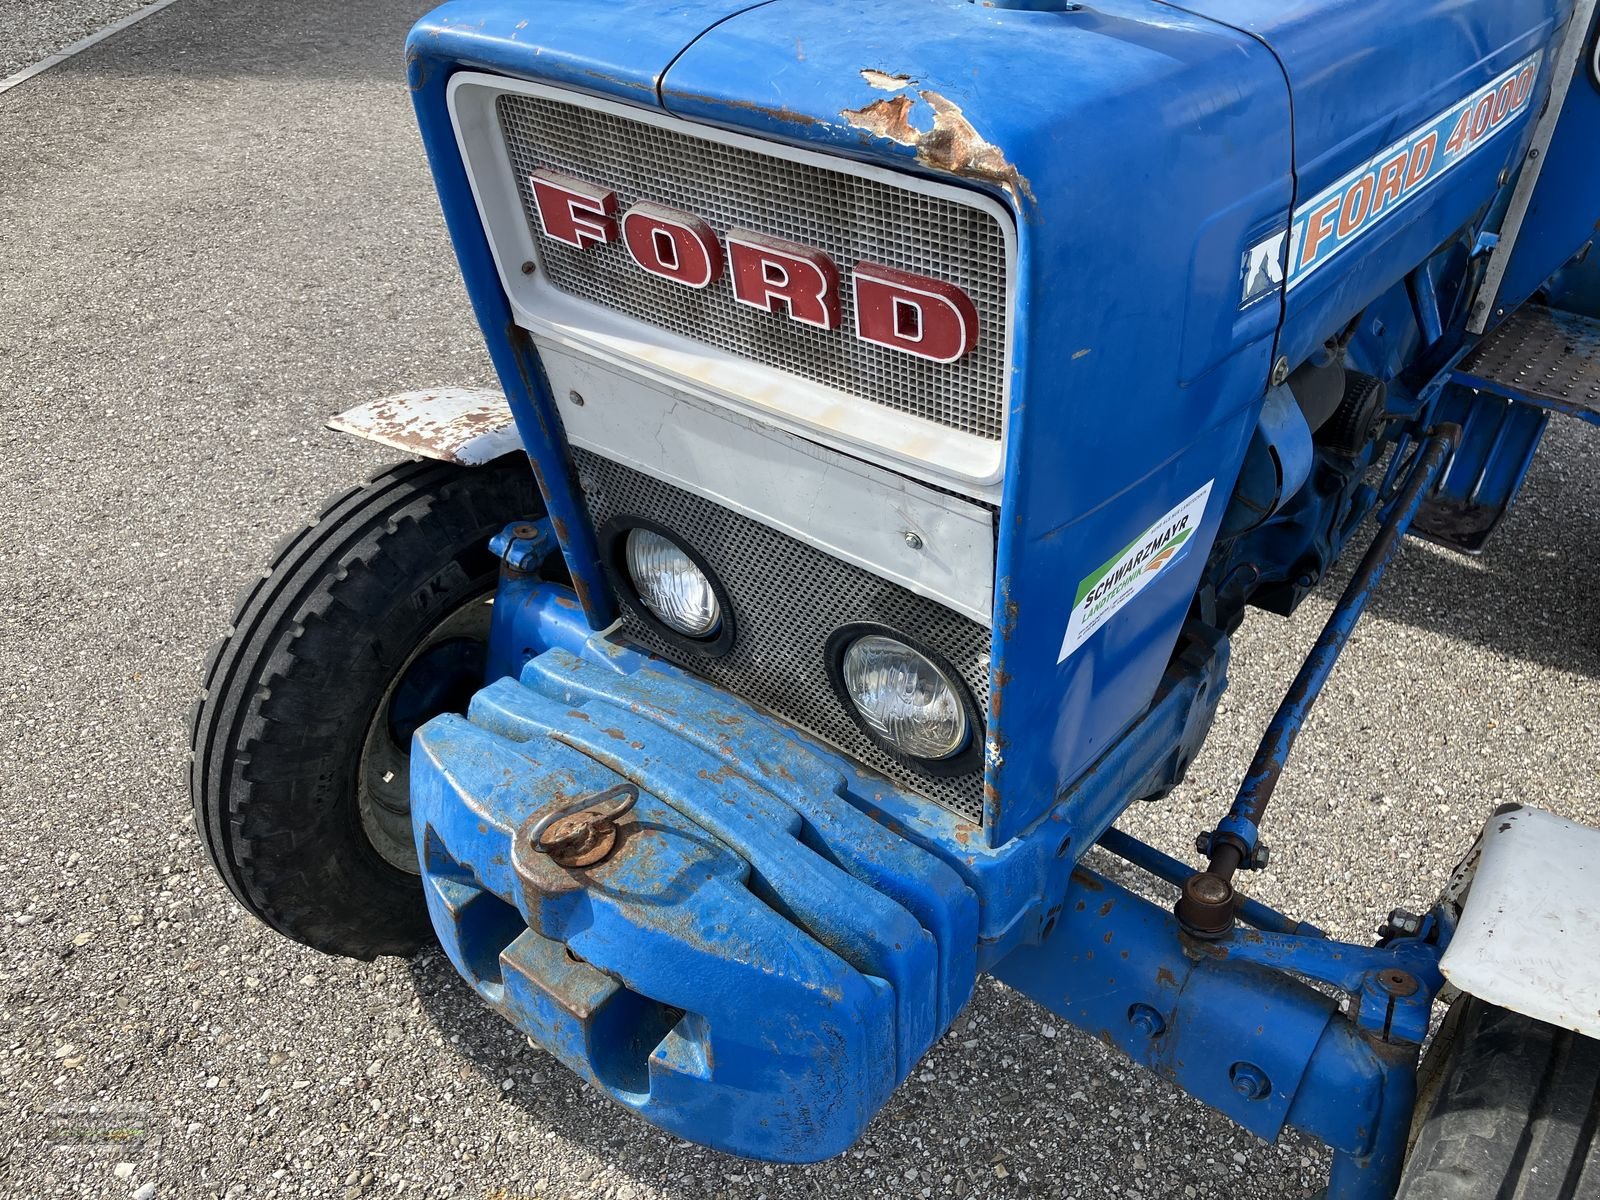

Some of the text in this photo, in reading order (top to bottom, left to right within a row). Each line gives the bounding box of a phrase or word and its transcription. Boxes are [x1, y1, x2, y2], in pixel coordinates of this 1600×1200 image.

[1300, 62, 1535, 266] FORD 4000
[529, 168, 979, 364] FORD
[1081, 566, 1143, 624] LANDTECHNIK
[1084, 514, 1189, 609] SCHWARZMAYR
